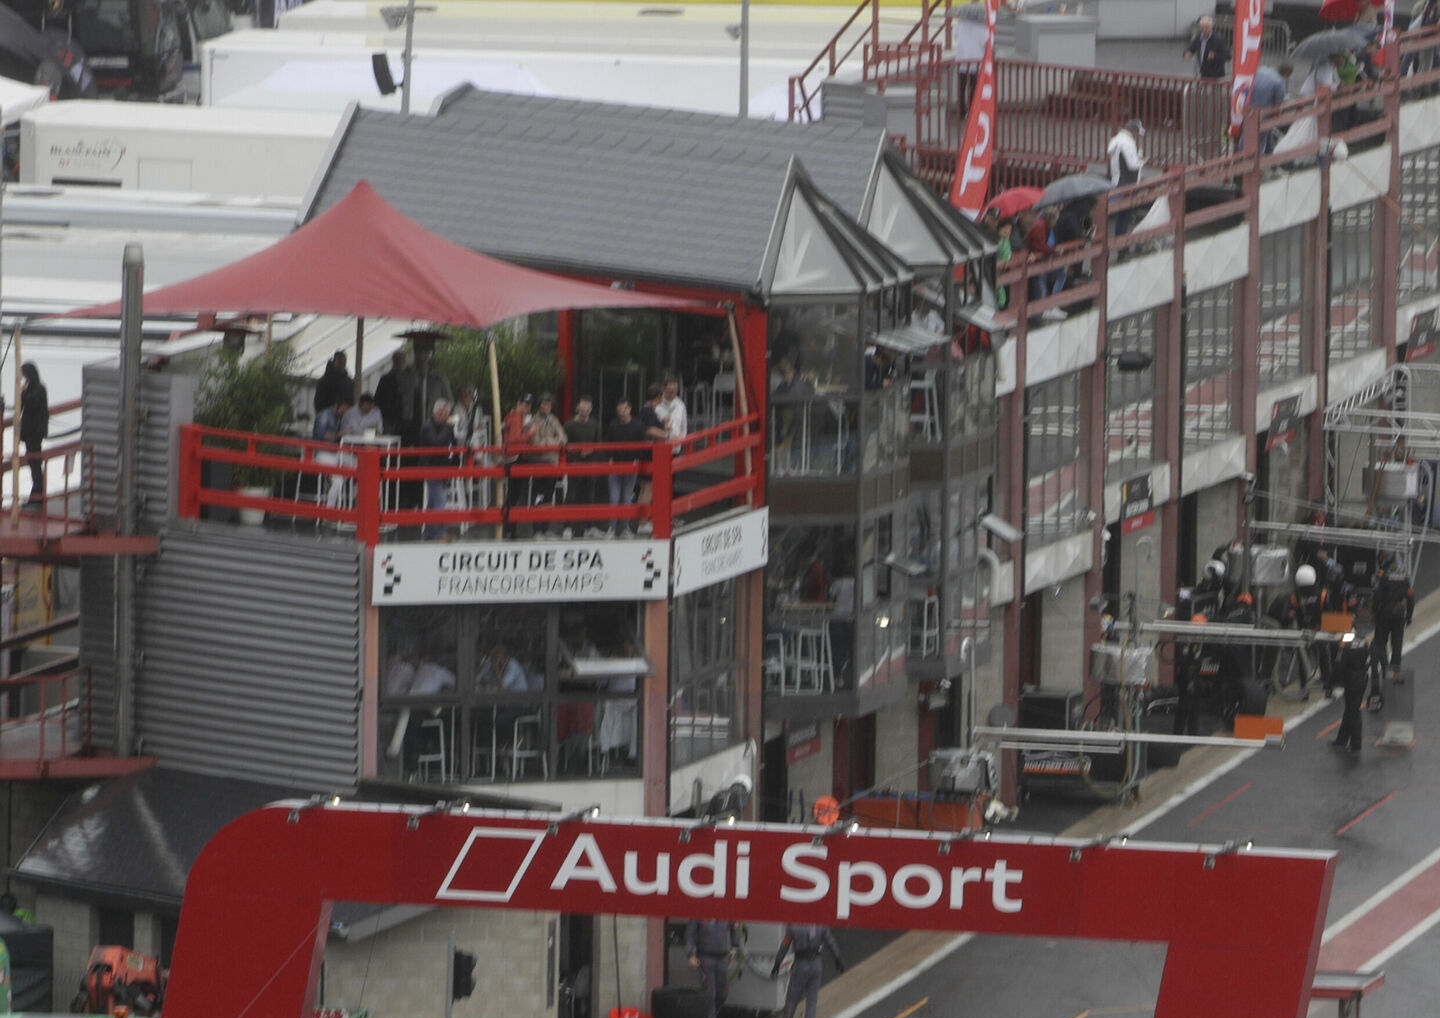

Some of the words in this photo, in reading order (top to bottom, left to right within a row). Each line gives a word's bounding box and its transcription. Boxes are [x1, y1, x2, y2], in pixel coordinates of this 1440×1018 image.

[438, 550, 522, 573] CIRCUIT
[528, 550, 557, 571] DE
[561, 549, 604, 571] SPA
[437, 573, 605, 596] FRANCORCHAMPS
[550, 832, 751, 899] Audi
[779, 842, 1024, 919] Sport
